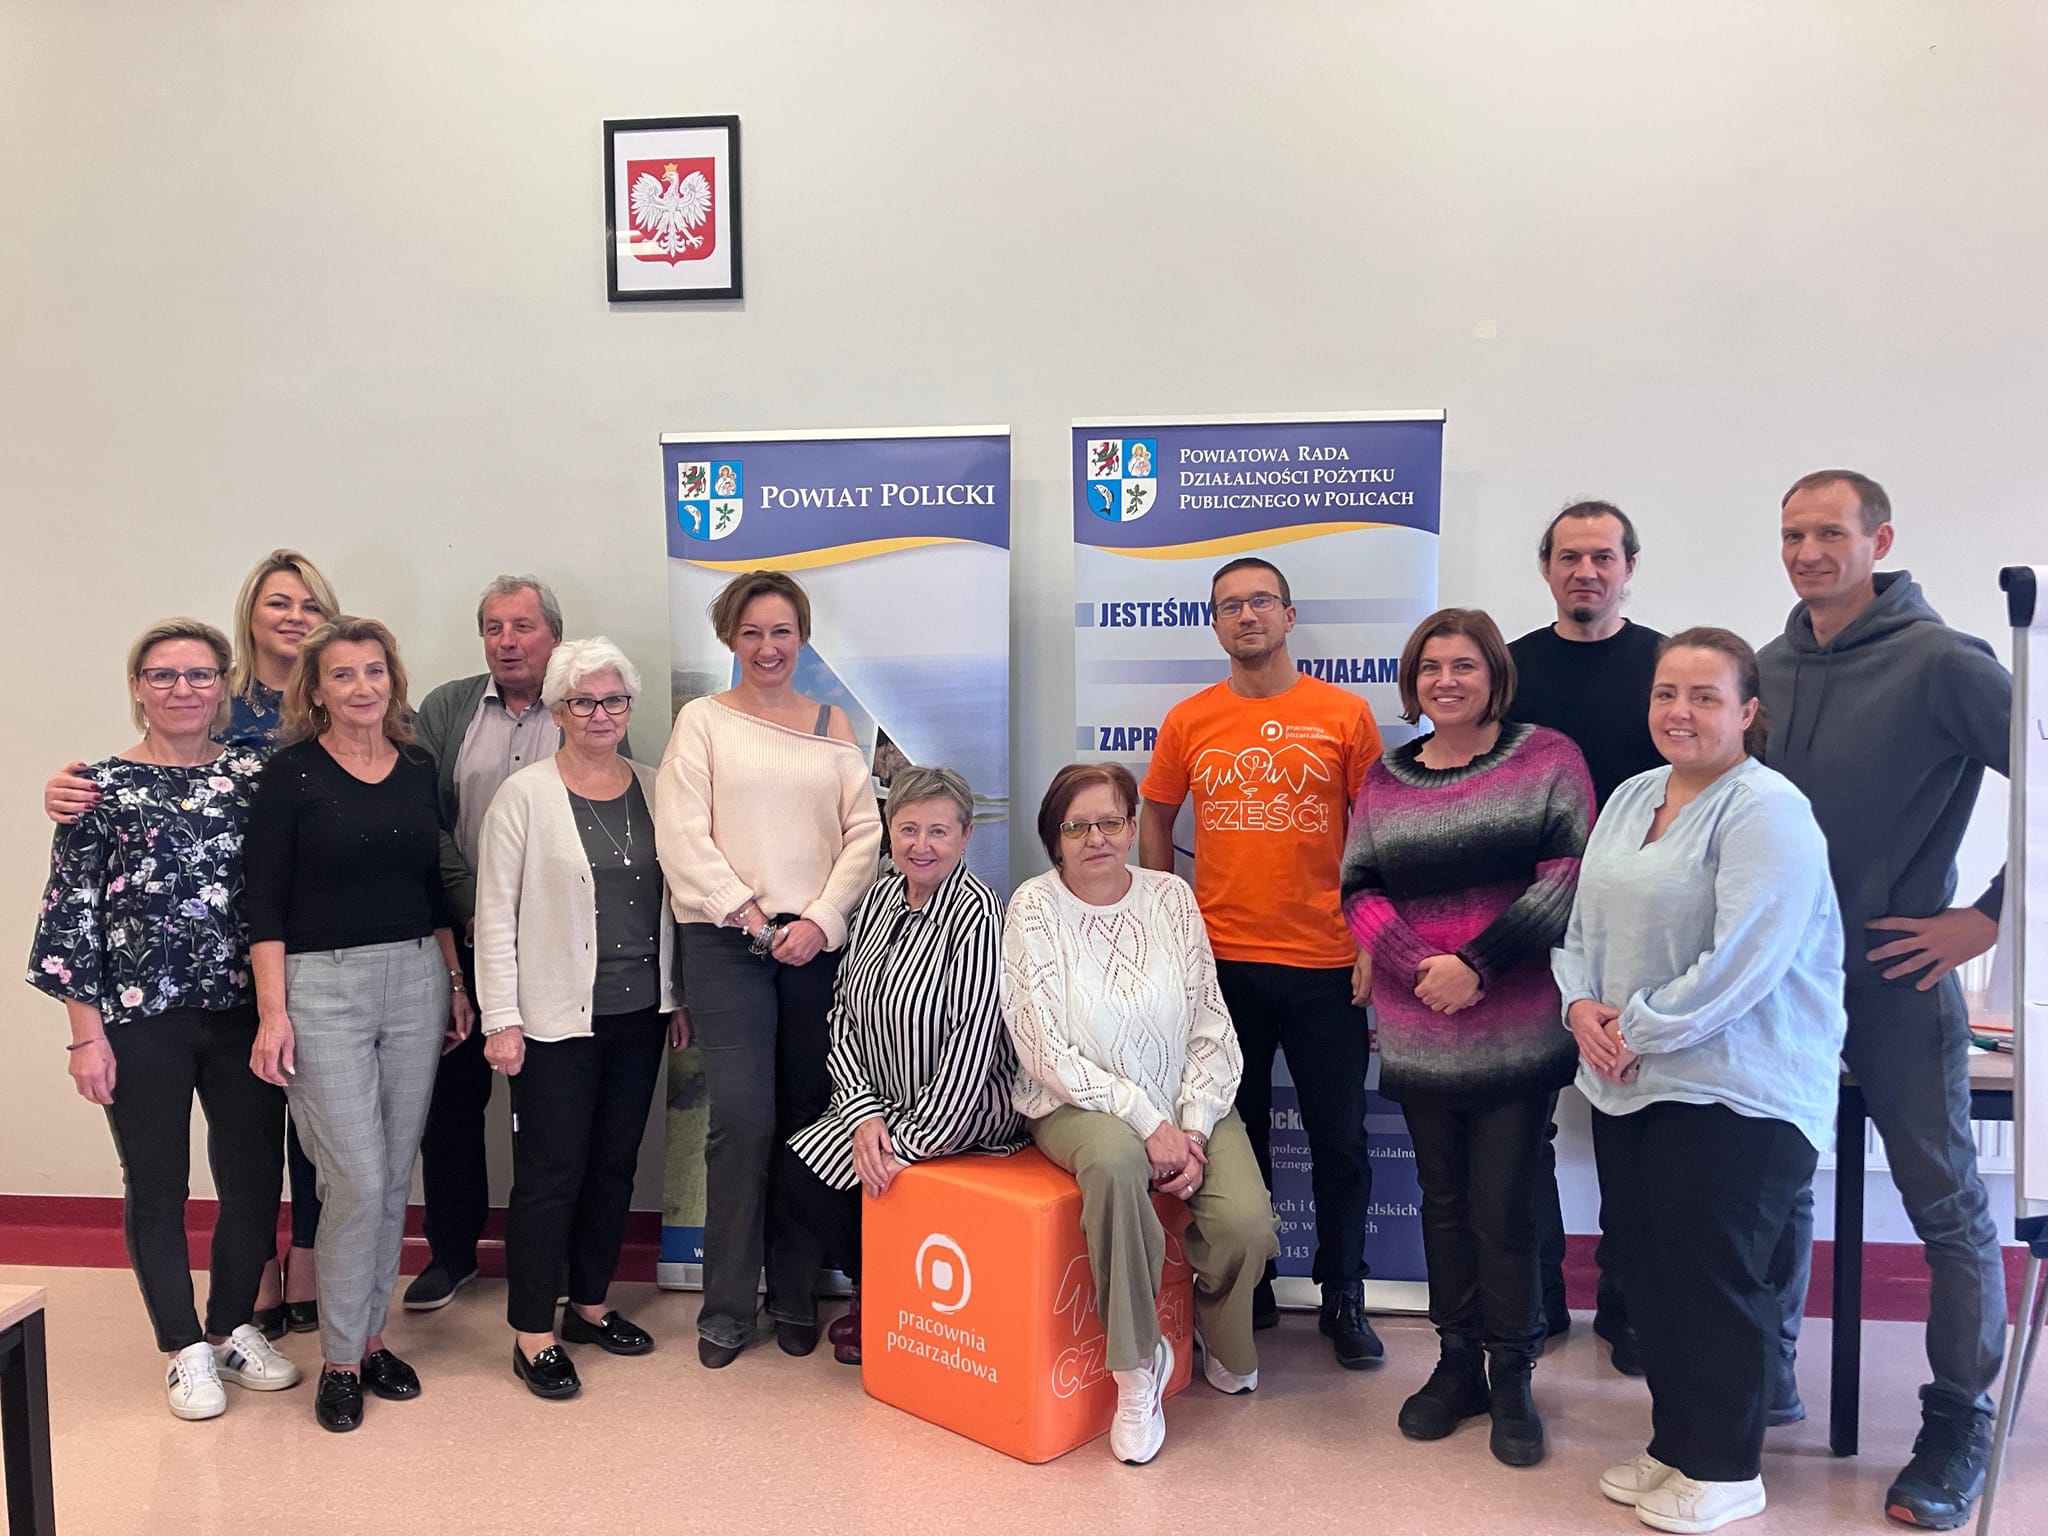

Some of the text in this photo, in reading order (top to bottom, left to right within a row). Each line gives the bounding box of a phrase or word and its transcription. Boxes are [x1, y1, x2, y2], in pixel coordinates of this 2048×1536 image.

[1180, 446, 1349, 464] POWIATOWA RADA
[1180, 465, 1395, 487] DZIAŁALNOŚCI POŻYTKU
[760, 484, 995, 509] POWIAT POLICKI
[1180, 494, 1300, 510] PUBLICZNEGO
[1325, 491, 1414, 506] POLICACH
[1099, 597, 1214, 627] JESTEŚMY
[1296, 658, 1403, 683] DZIAŁAM
[1201, 793, 1329, 834] CZEŚĆ!
[1366, 1203, 1418, 1216] elskich
[898, 1309, 987, 1353] pracownia
[886, 1331, 999, 1384] pozarządowa
